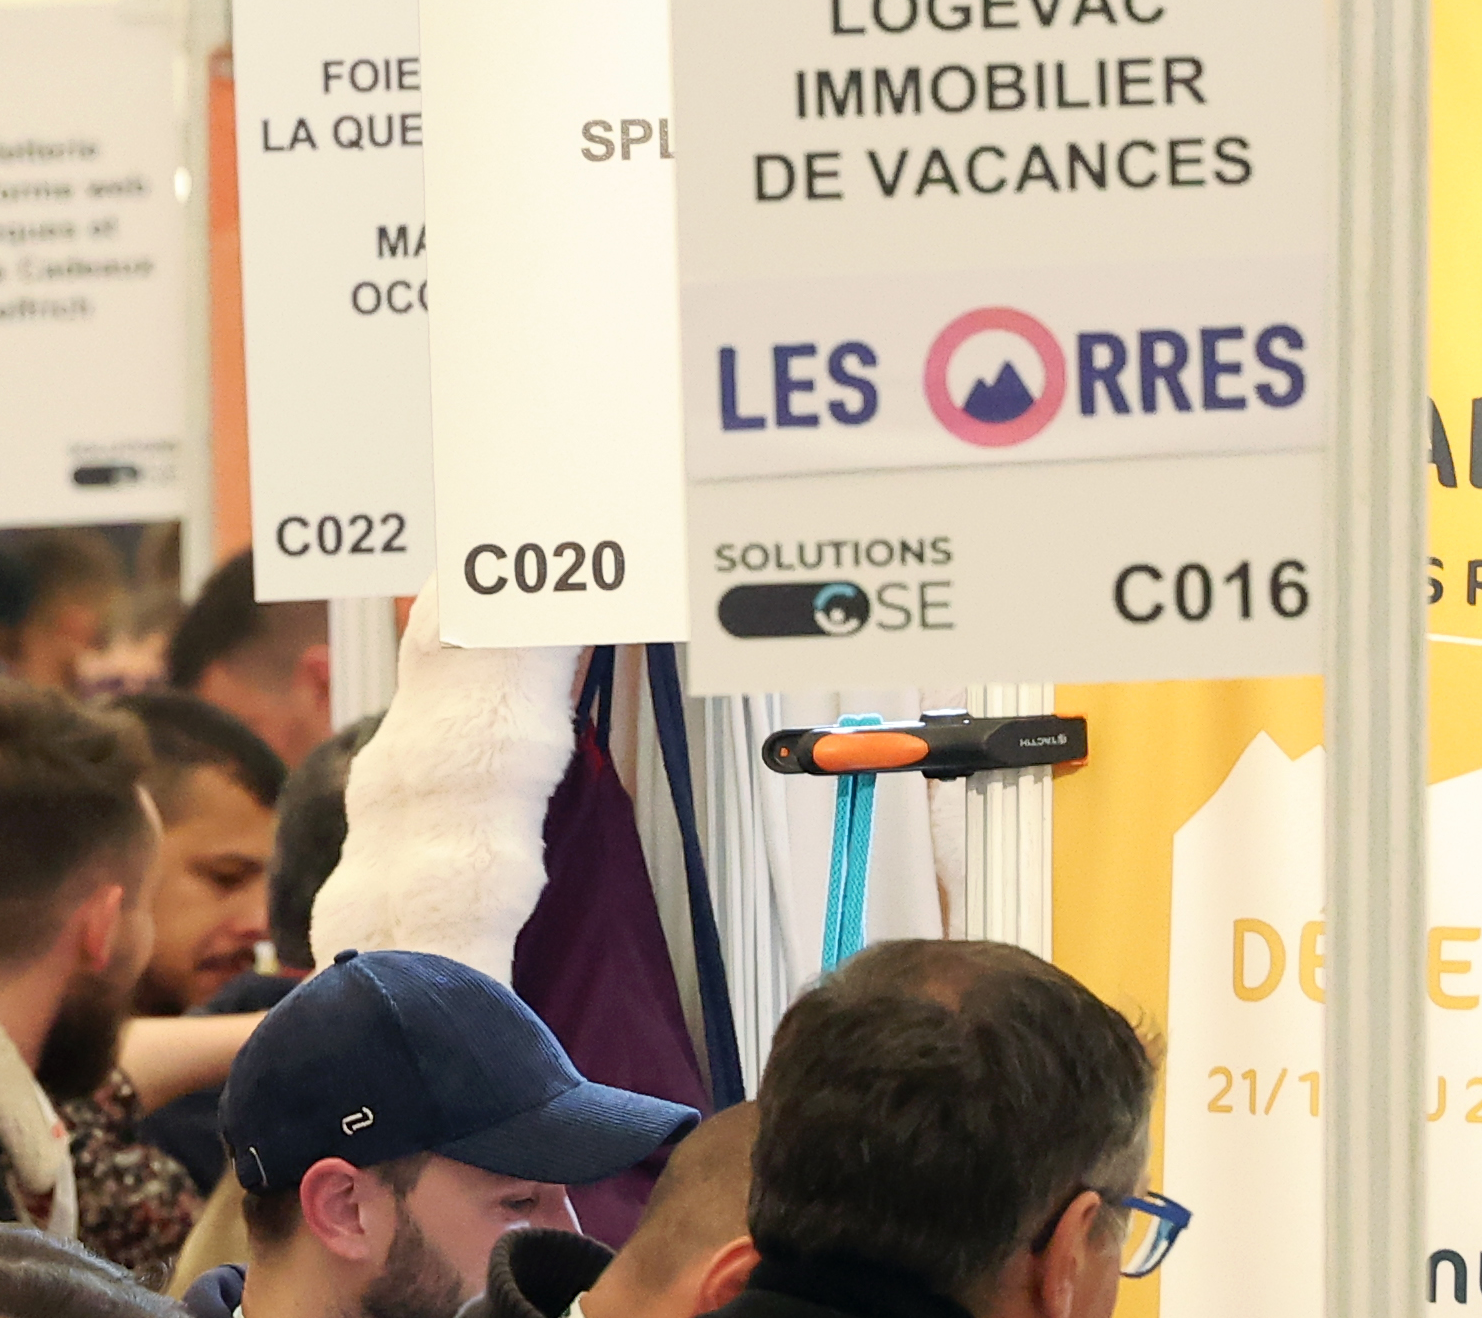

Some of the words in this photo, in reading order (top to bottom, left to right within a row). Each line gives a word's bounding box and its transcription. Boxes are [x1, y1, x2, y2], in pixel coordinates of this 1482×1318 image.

[322, 57, 421, 95] FOIE
[796, 56, 1206, 119] IMMOBILIER
[262, 117, 318, 153] LA
[332, 112, 423, 151] QUE
[581, 118, 676, 163] SPL
[754, 151, 843, 203] DE
[866, 136, 1253, 198] VACANCES
[714, 338, 884, 438] LES
[275, 512, 407, 558] C022
[714, 536, 953, 573] SOLUTIONS
[463, 540, 626, 596] C020
[1113, 559, 1310, 625] C016
